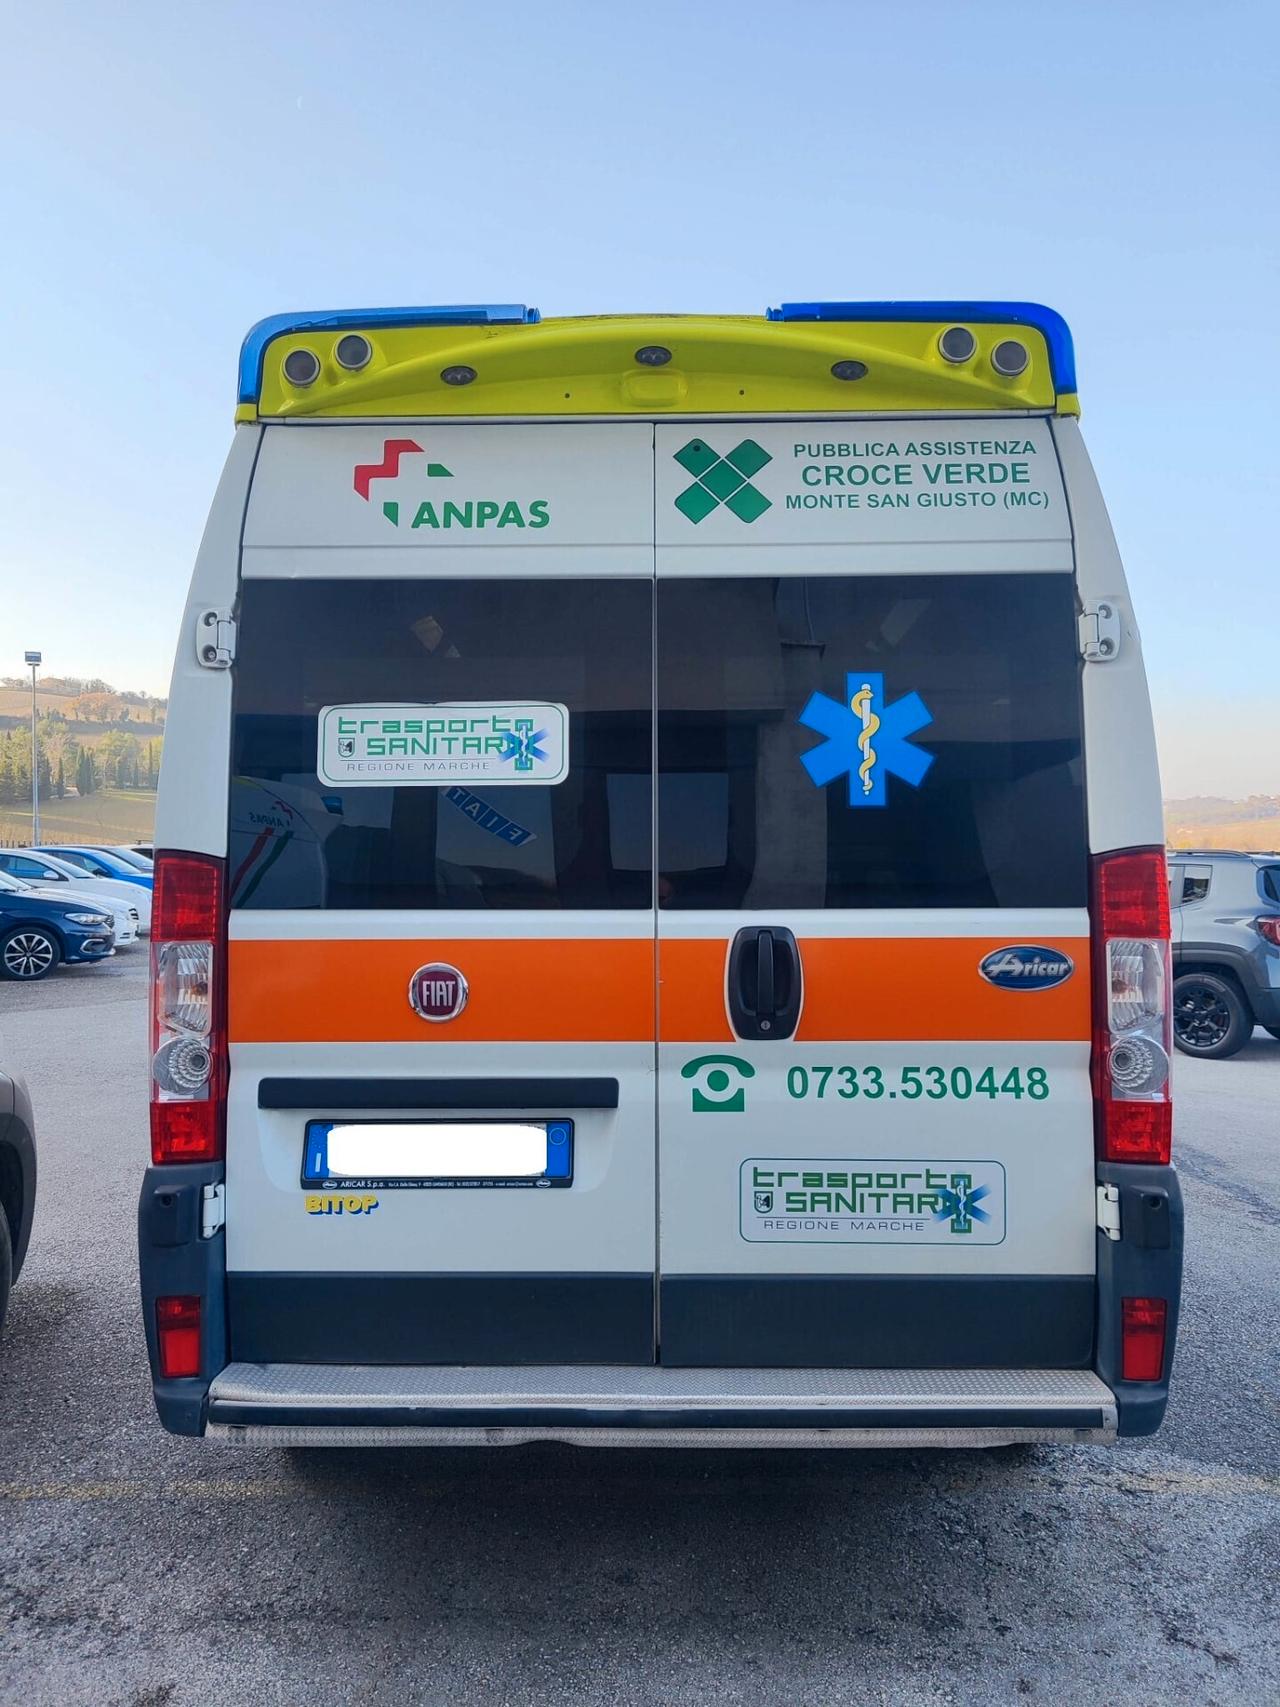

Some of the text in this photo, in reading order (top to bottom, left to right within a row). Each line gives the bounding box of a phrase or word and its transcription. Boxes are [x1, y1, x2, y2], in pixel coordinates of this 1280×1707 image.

[793, 440, 1036, 458] PUBBLICA ASSISTENZA
[801, 462, 1031, 487] CROCE VERDE
[785, 491, 1050, 510] MONTE SAN GIUSTO (MC)
[410, 500, 550, 529] ANPAS
[346, 761, 490, 772] REGIONE MARCHE
[983, 953, 1069, 978] Aricar
[422, 980, 456, 1007] FIAT
[786, 1065, 1050, 1100] 0733.530448
[340, 1180, 366, 1188] ARICAR
[305, 1194, 380, 1215] BITOP
[763, 1220, 925, 1232] REGIONE MARCHE
